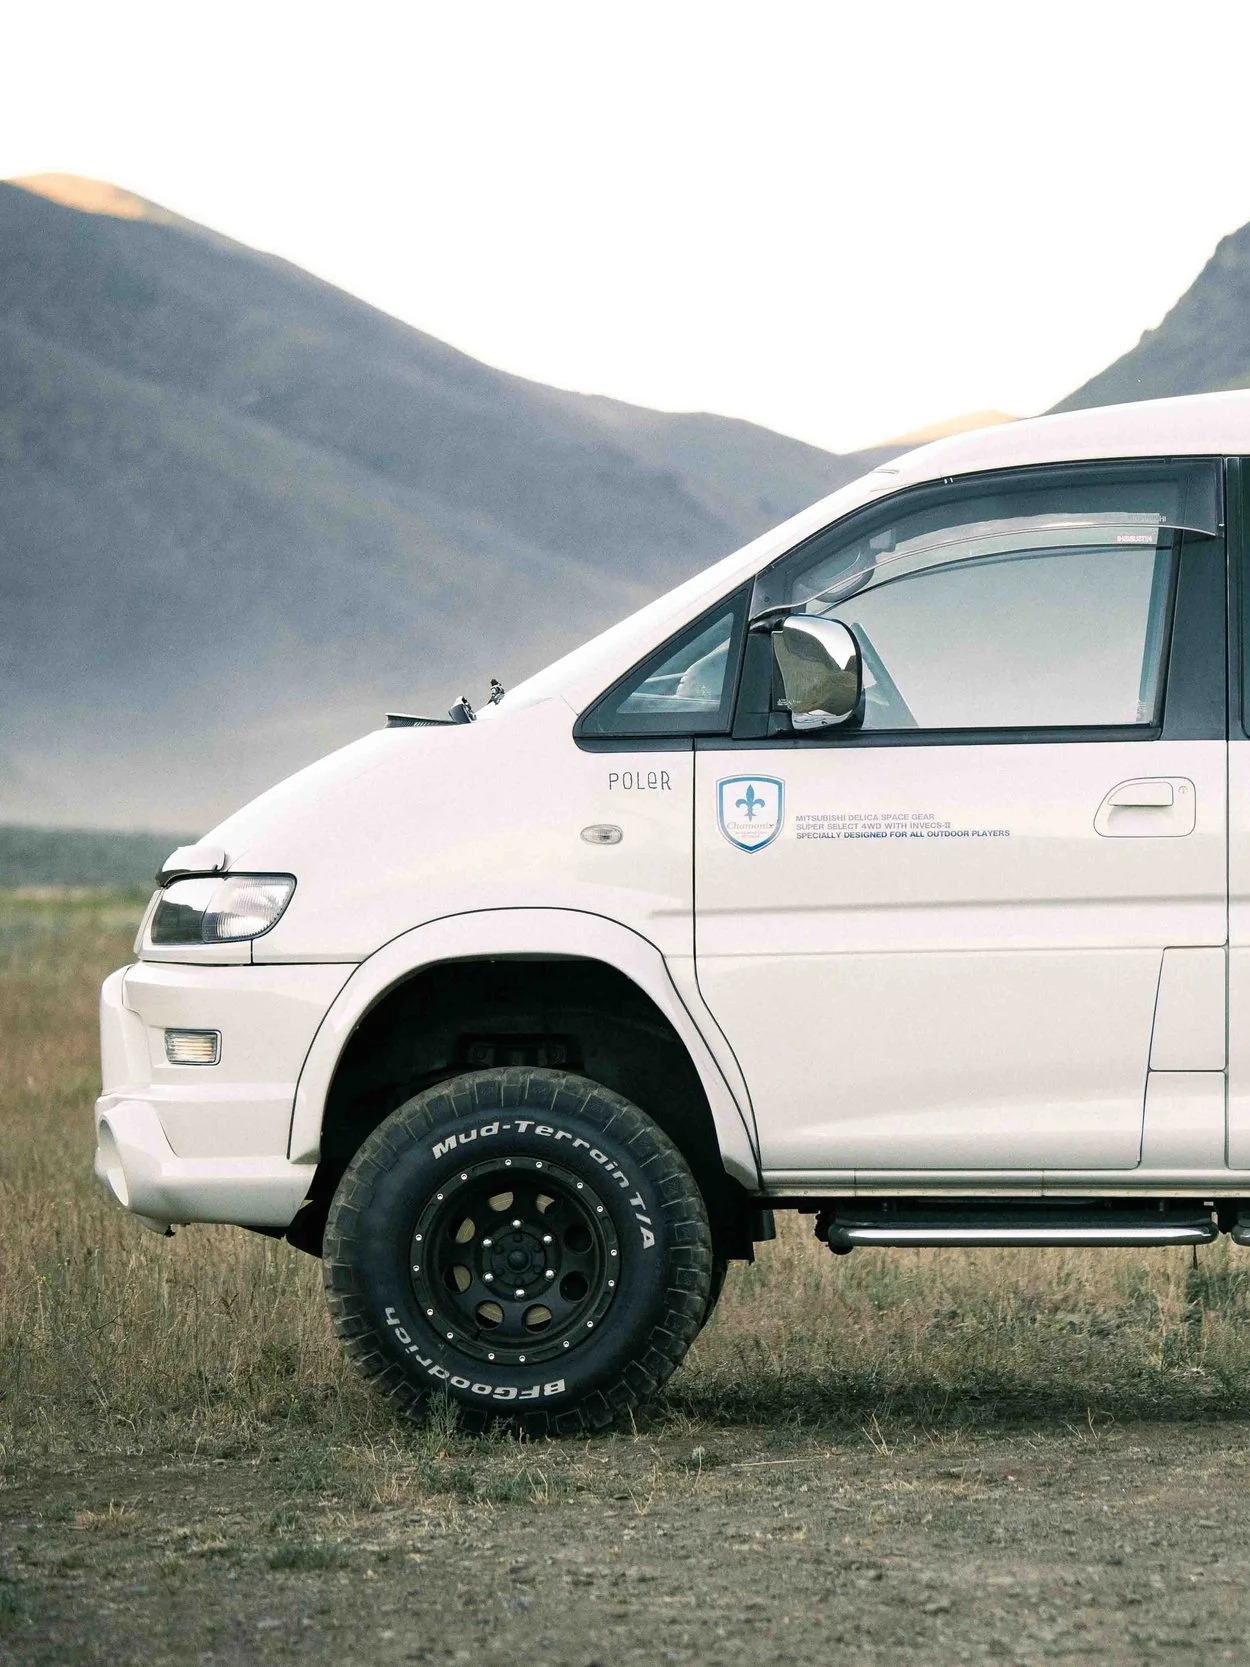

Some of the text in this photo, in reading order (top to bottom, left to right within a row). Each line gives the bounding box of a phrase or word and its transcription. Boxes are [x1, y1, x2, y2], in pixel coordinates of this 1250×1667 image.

[795, 814, 846, 822] MITSUBISHI
[881, 813, 910, 821] SPACE
[911, 813, 935, 821] GEAR
[796, 822, 825, 830] SUPER
[827, 822, 859, 830] SELECT
[861, 822, 882, 830] 4WD
[796, 831, 841, 839] SPECIALLY
[843, 831, 887, 839] DESIGNED
[926, 830, 970, 838] OUTDOOR
[971, 829, 1010, 837] PLAYERS
[432, 1120, 655, 1249] Mud-Terrain T/A
[384, 1307, 566, 1400] BFGoodrich
